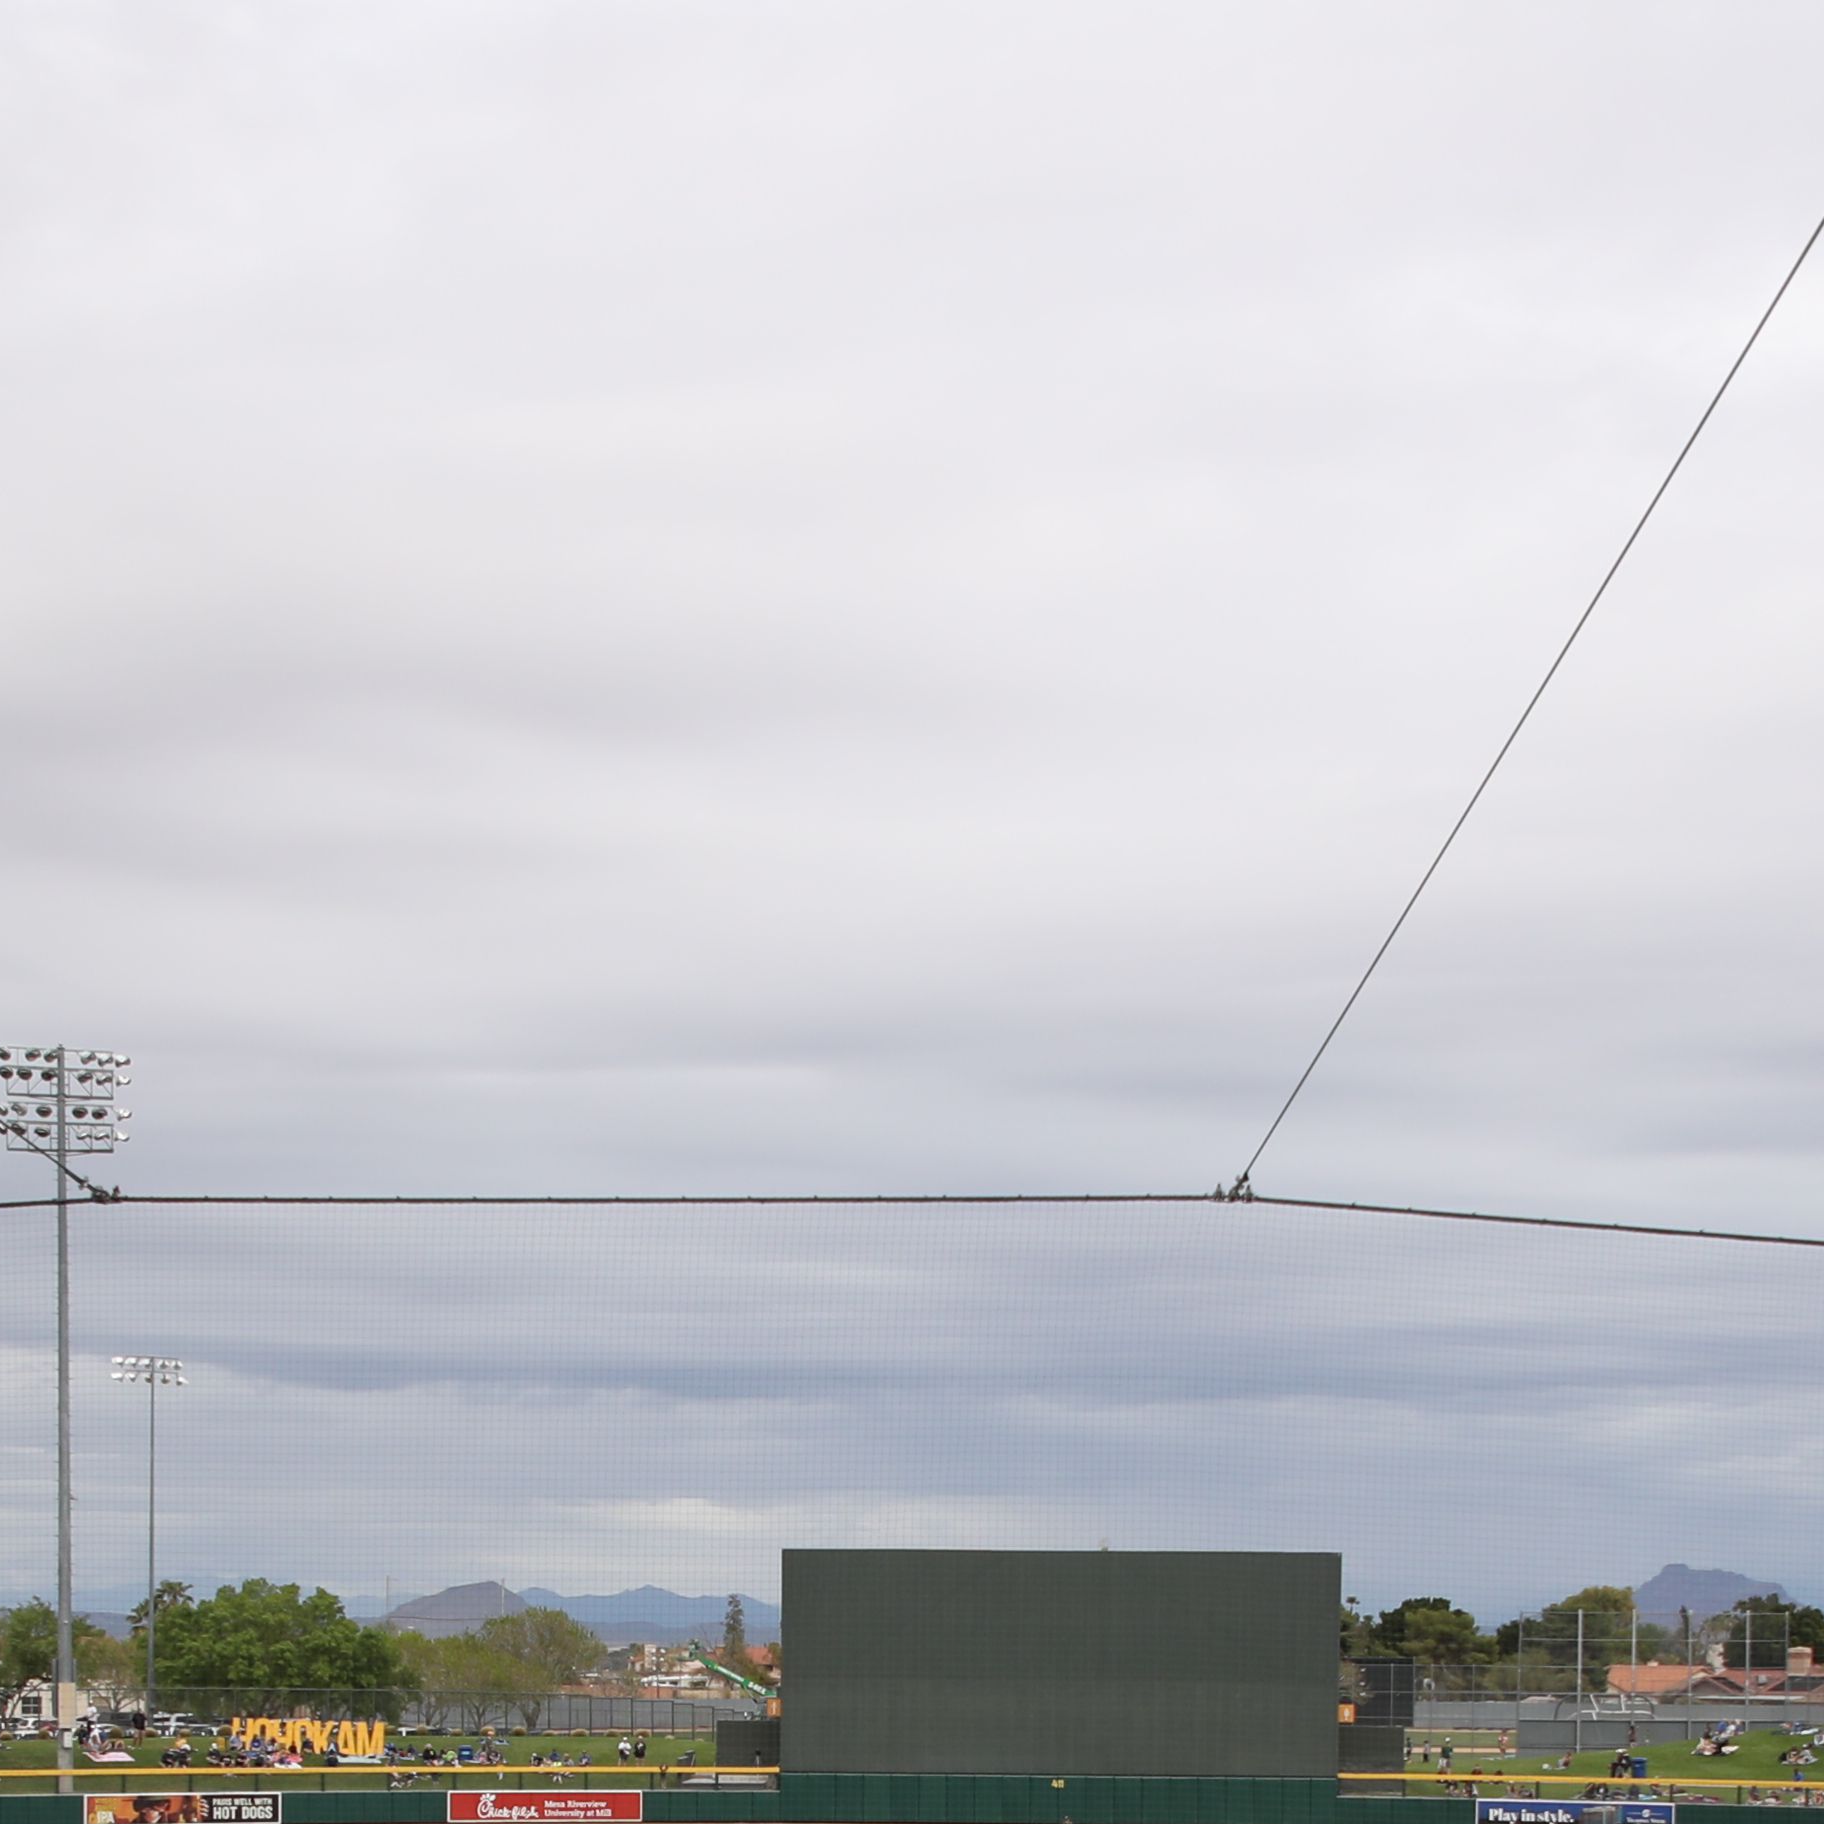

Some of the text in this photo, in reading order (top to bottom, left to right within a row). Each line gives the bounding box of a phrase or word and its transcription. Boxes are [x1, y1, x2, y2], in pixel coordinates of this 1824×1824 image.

[231, 1716, 385, 1756] HOHOKAM
[233, 1798, 253, 1806] WELL
[212, 1806, 273, 1819] HOT DOGS
[544, 1809, 585, 1819] University
[596, 1809, 612, 1817] Mill
[1521, 1808, 1535, 1822] in
